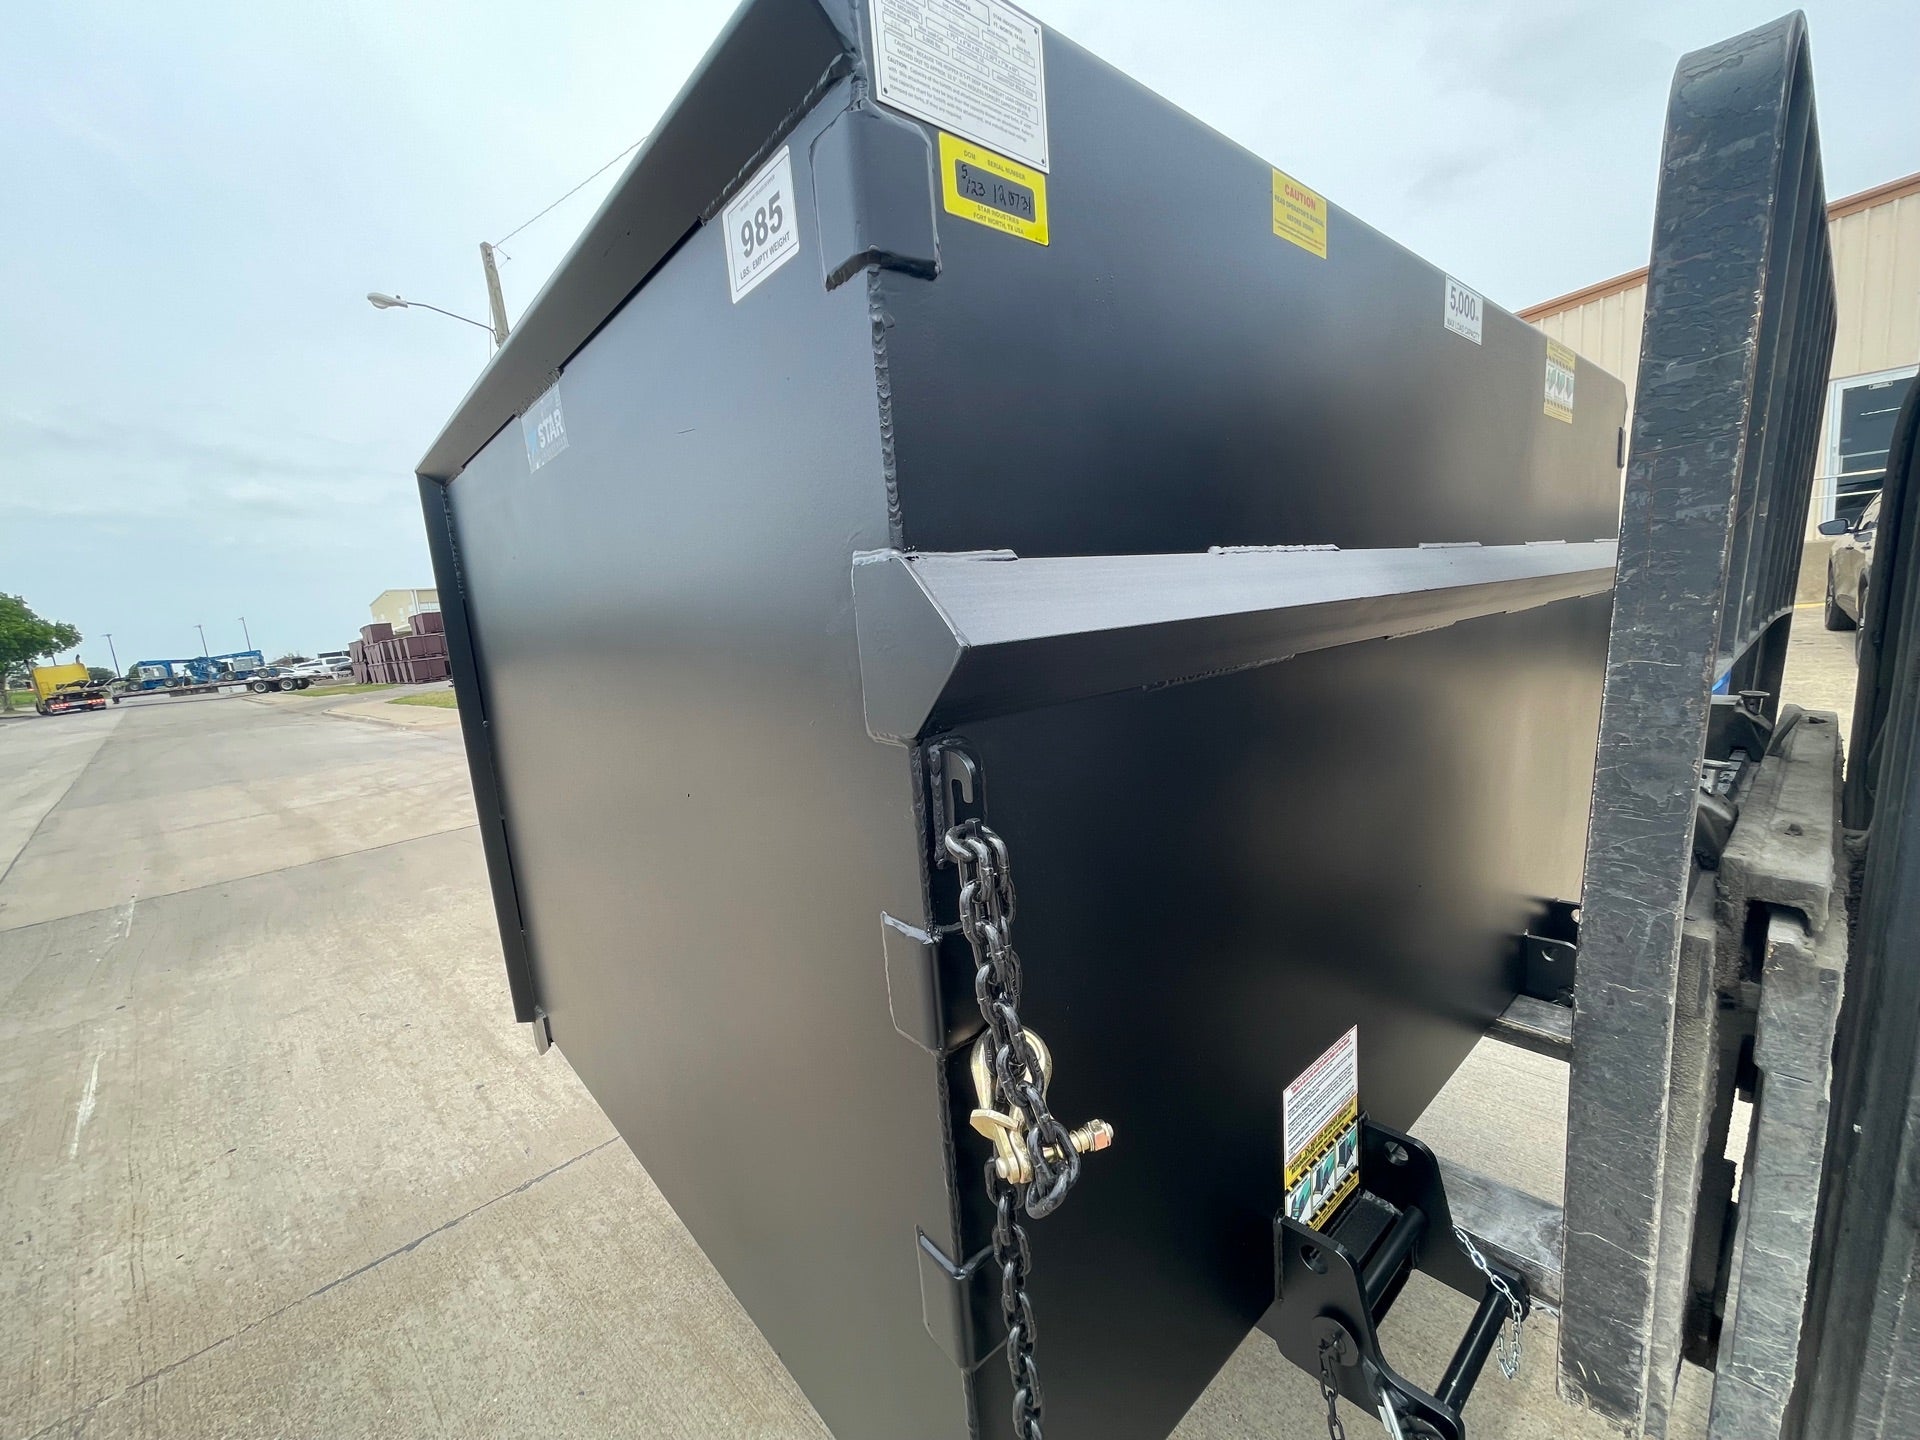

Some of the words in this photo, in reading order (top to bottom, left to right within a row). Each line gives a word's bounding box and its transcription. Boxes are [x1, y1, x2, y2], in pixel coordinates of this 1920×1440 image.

[964, 150, 976, 160] DOM
[988, 160, 1004, 172] SERIAL
[1005, 165, 1026, 180] NUMBER
[1284, 184, 1316, 210] CAUTION
[741, 190, 782, 258] 985
[973, 212, 988, 222] FORT
[1014, 225, 1024, 235] USA
[977, 204, 991, 216] STAR
[991, 208, 1020, 224] INDUSTRIES
[740, 267, 751, 280] LBS.
[752, 250, 769, 270] EMPTY
[770, 232, 790, 255] WEIGHT
[1450, 286, 1476, 320] 5,000
[538, 408, 564, 448] STAR
